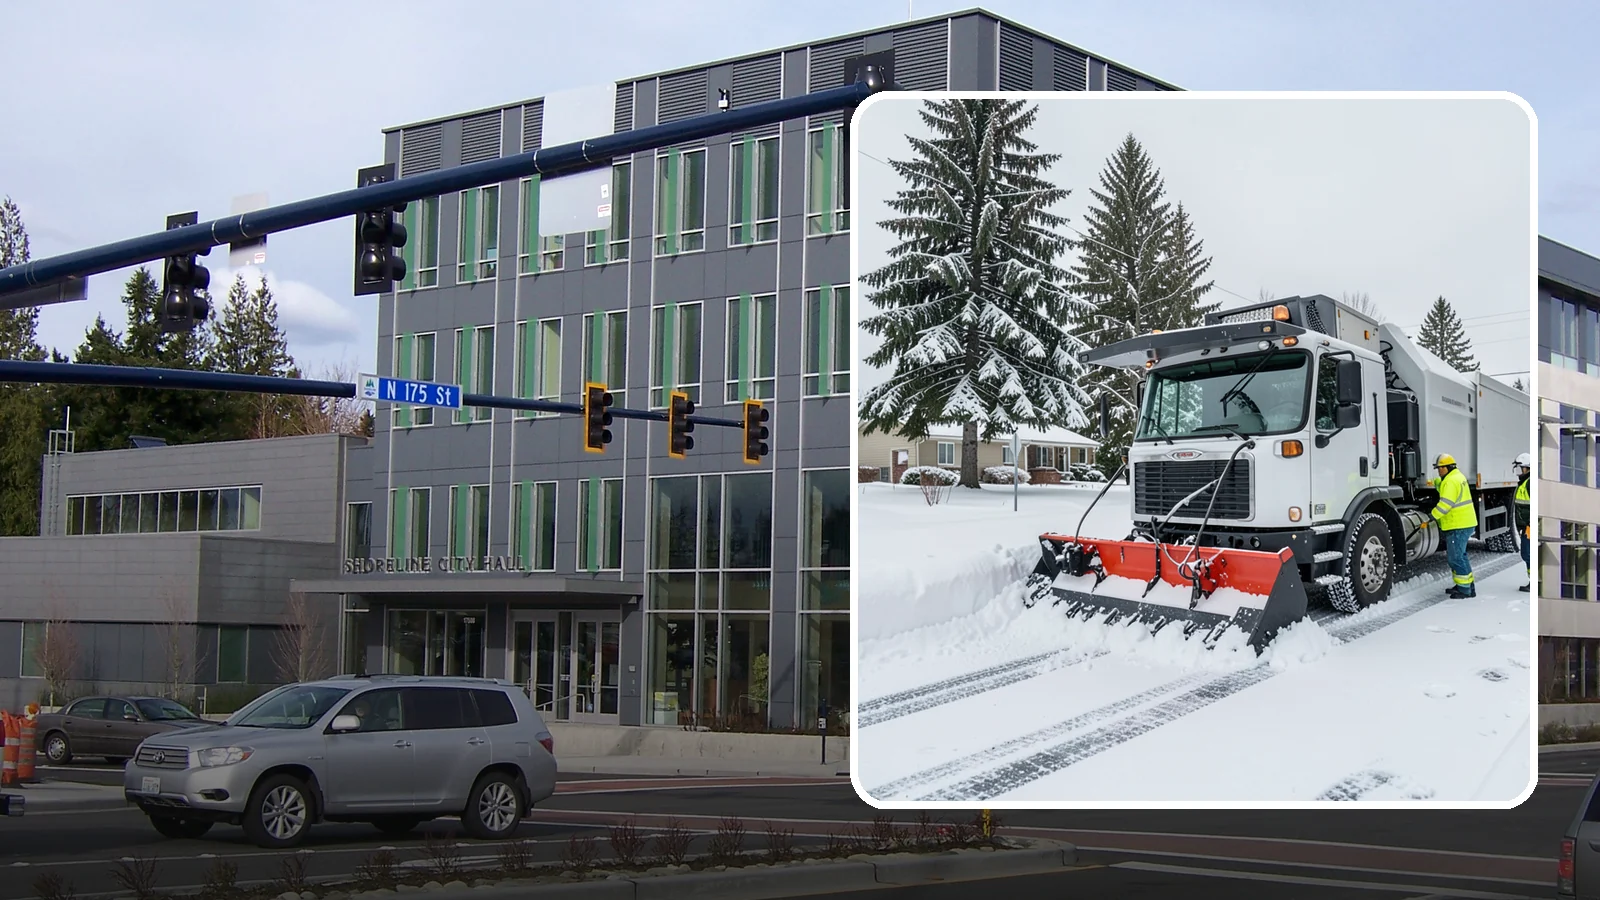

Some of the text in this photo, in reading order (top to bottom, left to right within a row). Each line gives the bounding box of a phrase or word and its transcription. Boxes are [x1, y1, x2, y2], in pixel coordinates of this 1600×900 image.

[387, 381, 451, 406] N 175 St
[344, 555, 525, 574] SHORELINE CITY HALL
